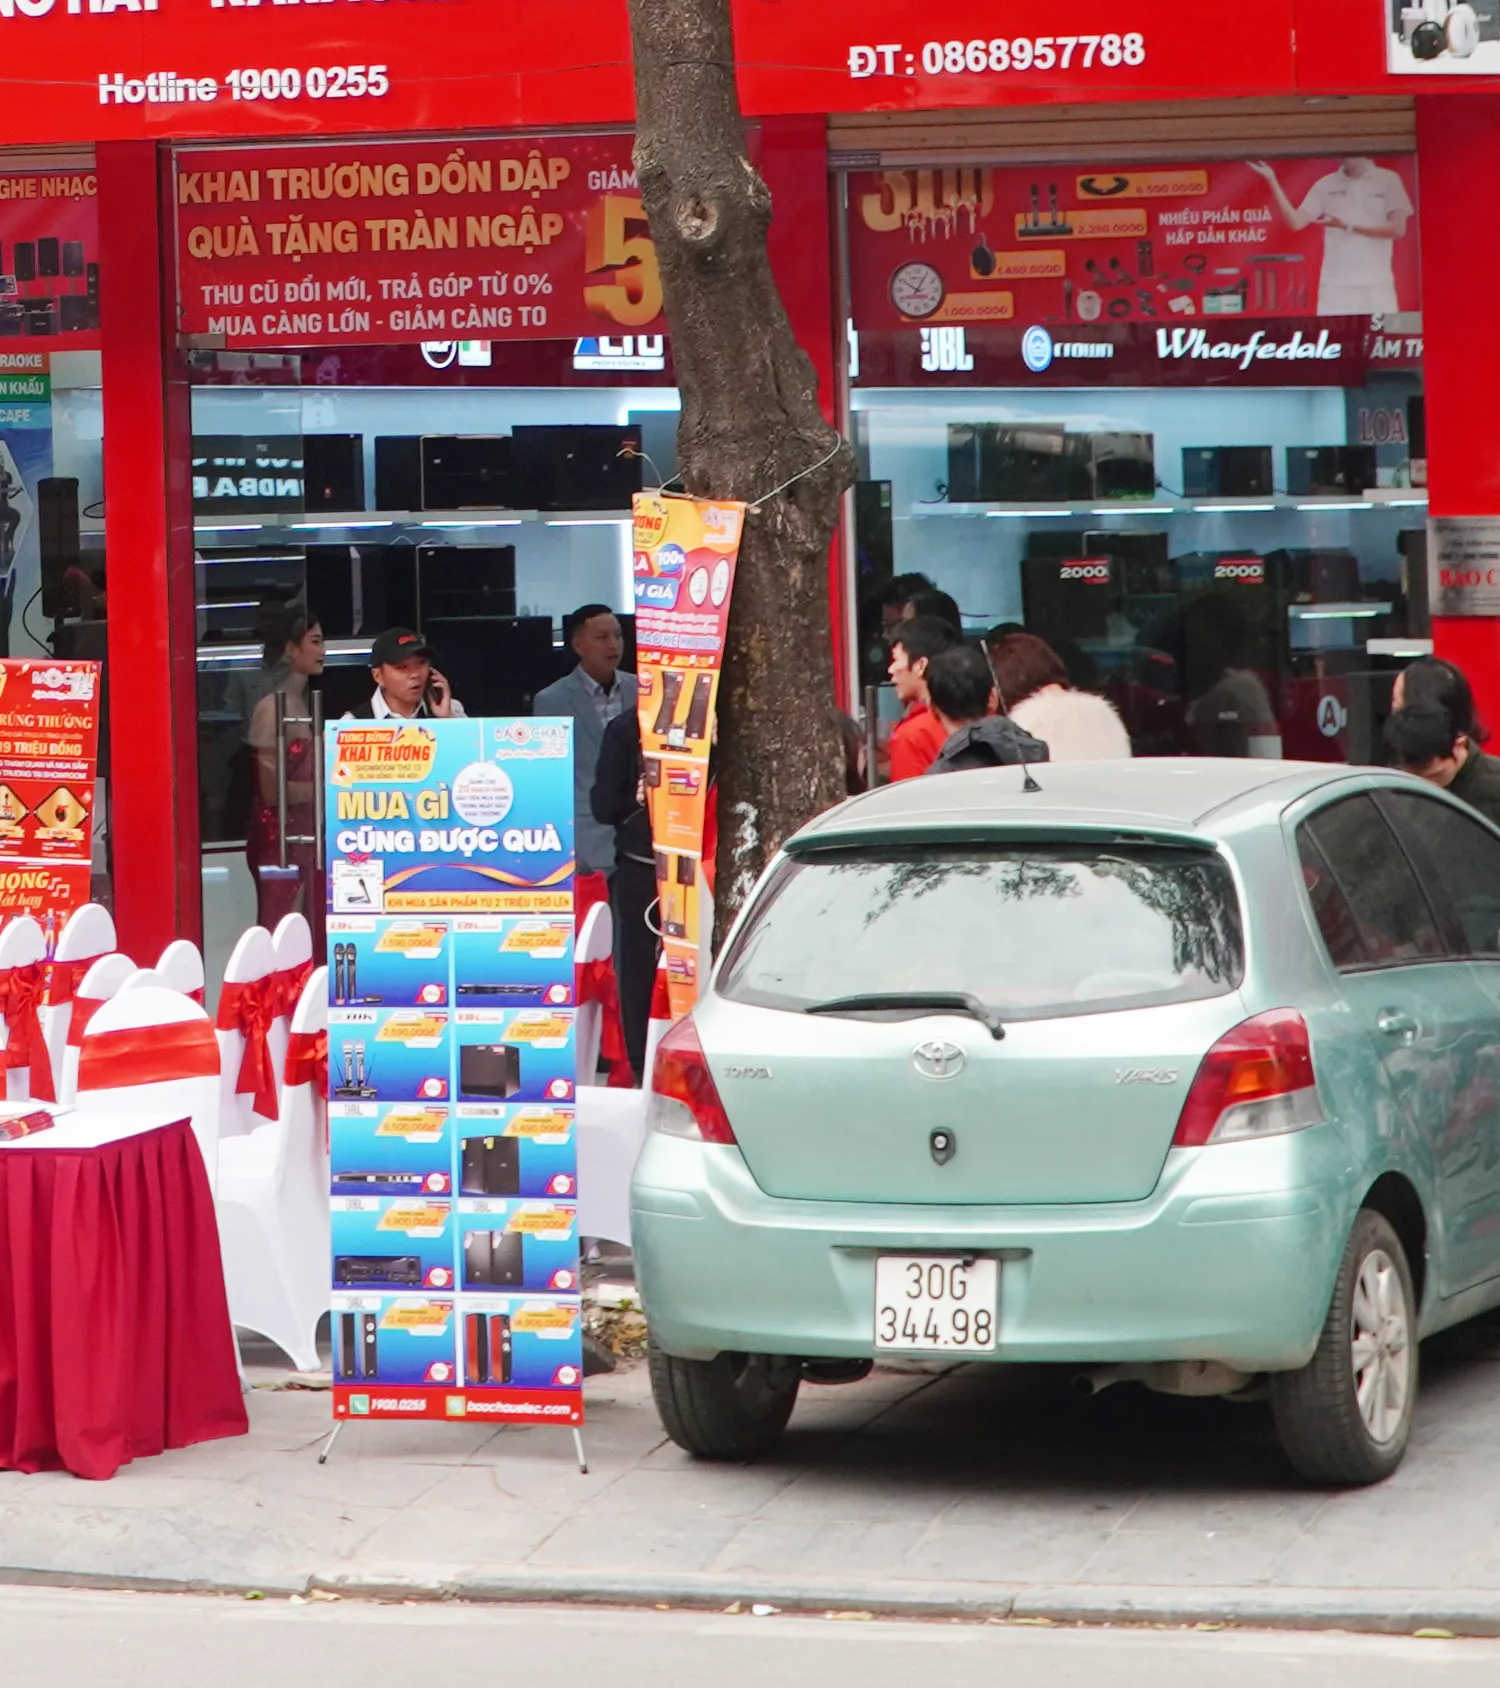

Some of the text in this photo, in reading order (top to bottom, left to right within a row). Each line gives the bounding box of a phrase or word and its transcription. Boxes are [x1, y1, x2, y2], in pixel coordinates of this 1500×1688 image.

[922, 32, 1145, 77] 0868957788
[97, 69, 217, 106] Hotline
[178, 147, 571, 205] KHAI TRƯƠNG DỒN DẬP
[1155, 326, 1342, 370] Wharfedale
[336, 790, 409, 820] MUA
[414, 779, 449, 819] GÌ
[336, 824, 561, 857] CŨNG ĐƯỢC QUÀ
[905, 1263, 967, 1301] 30G
[879, 1307, 992, 1346] 344.98
